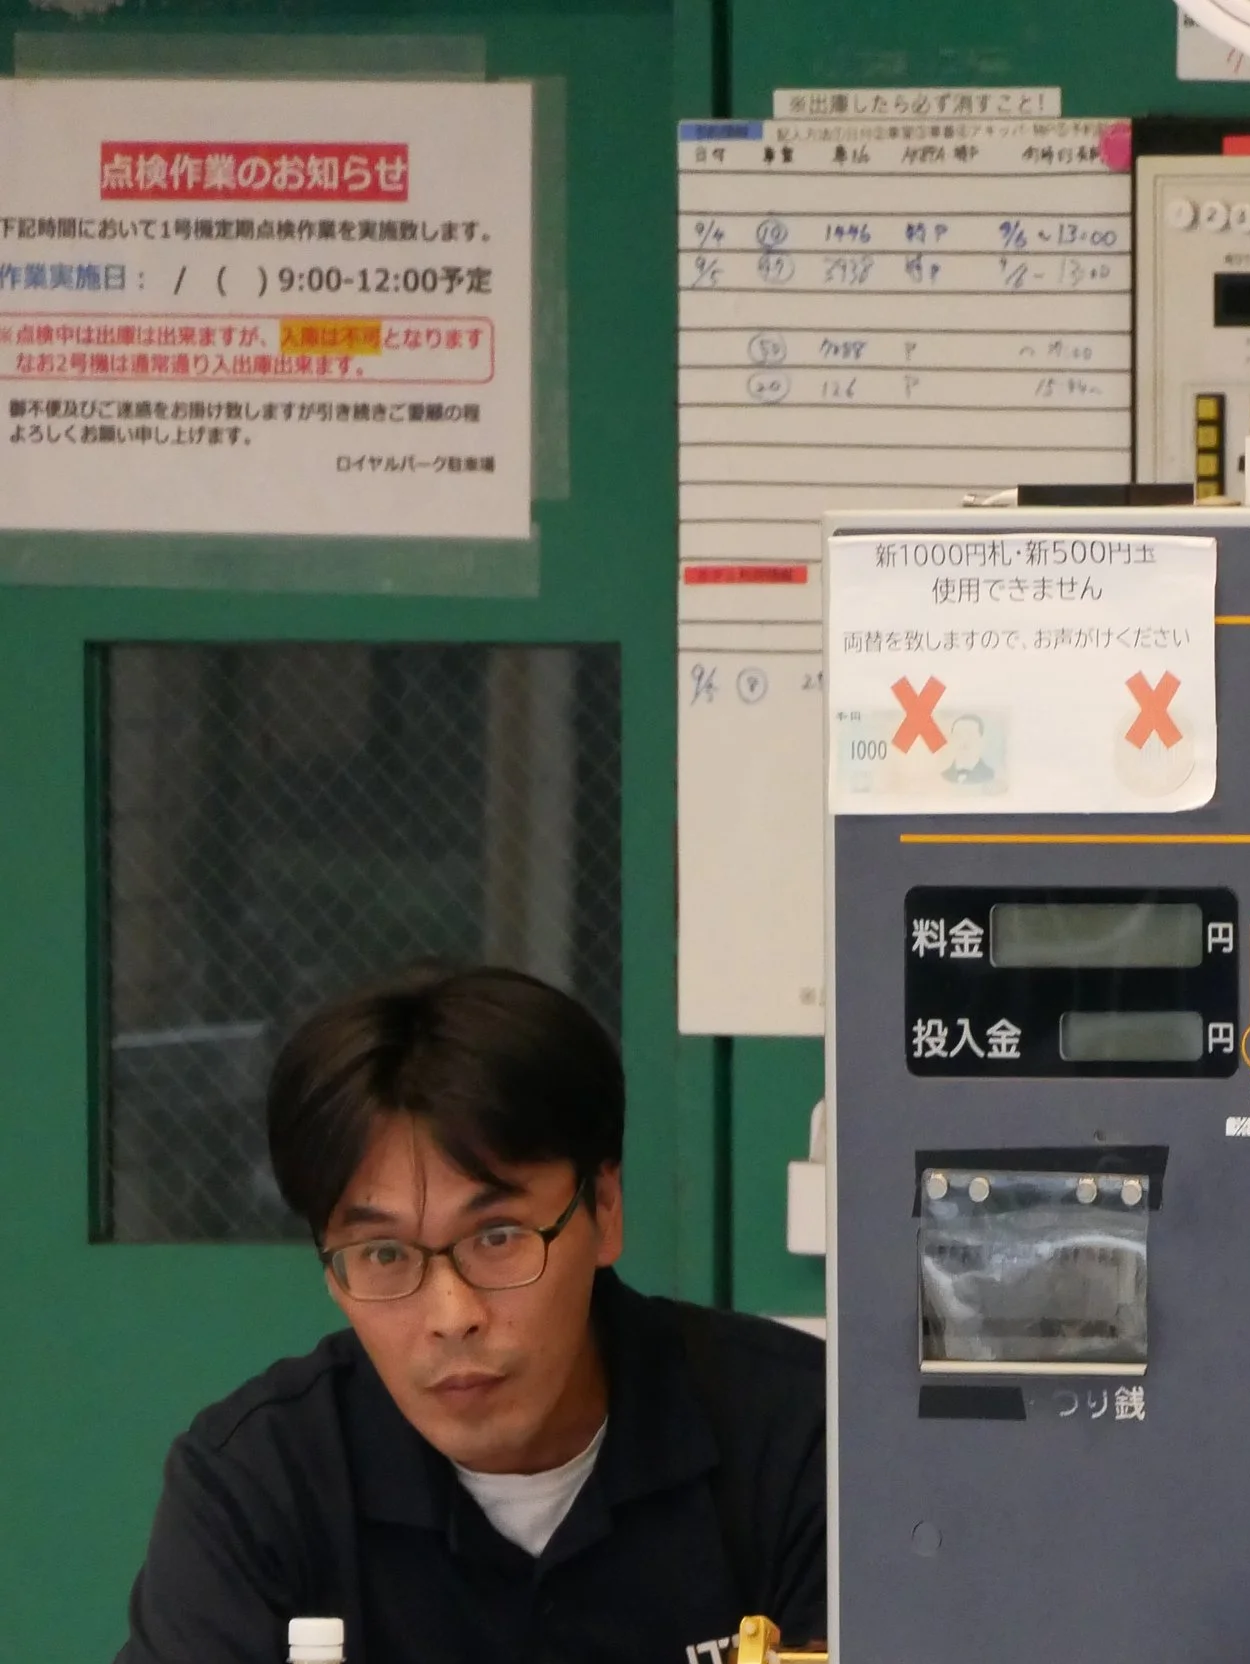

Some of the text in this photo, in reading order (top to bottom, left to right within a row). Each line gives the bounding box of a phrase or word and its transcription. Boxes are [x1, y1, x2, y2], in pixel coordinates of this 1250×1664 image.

[102, 154, 407, 192] 点検作業のお知らせ
[336, 456, 496, 473] ロイヤルパーク駐車場
[932, 576, 1103, 604] 使用できません
[843, 628, 1190, 653] 両替を致しますので、お声がけください
[850, 740, 888, 760] 1000
[911, 918, 984, 959] 料金
[1208, 922, 1234, 954] 円
[912, 1018, 1022, 1059] 投入金
[1209, 1022, 1234, 1054] 円
